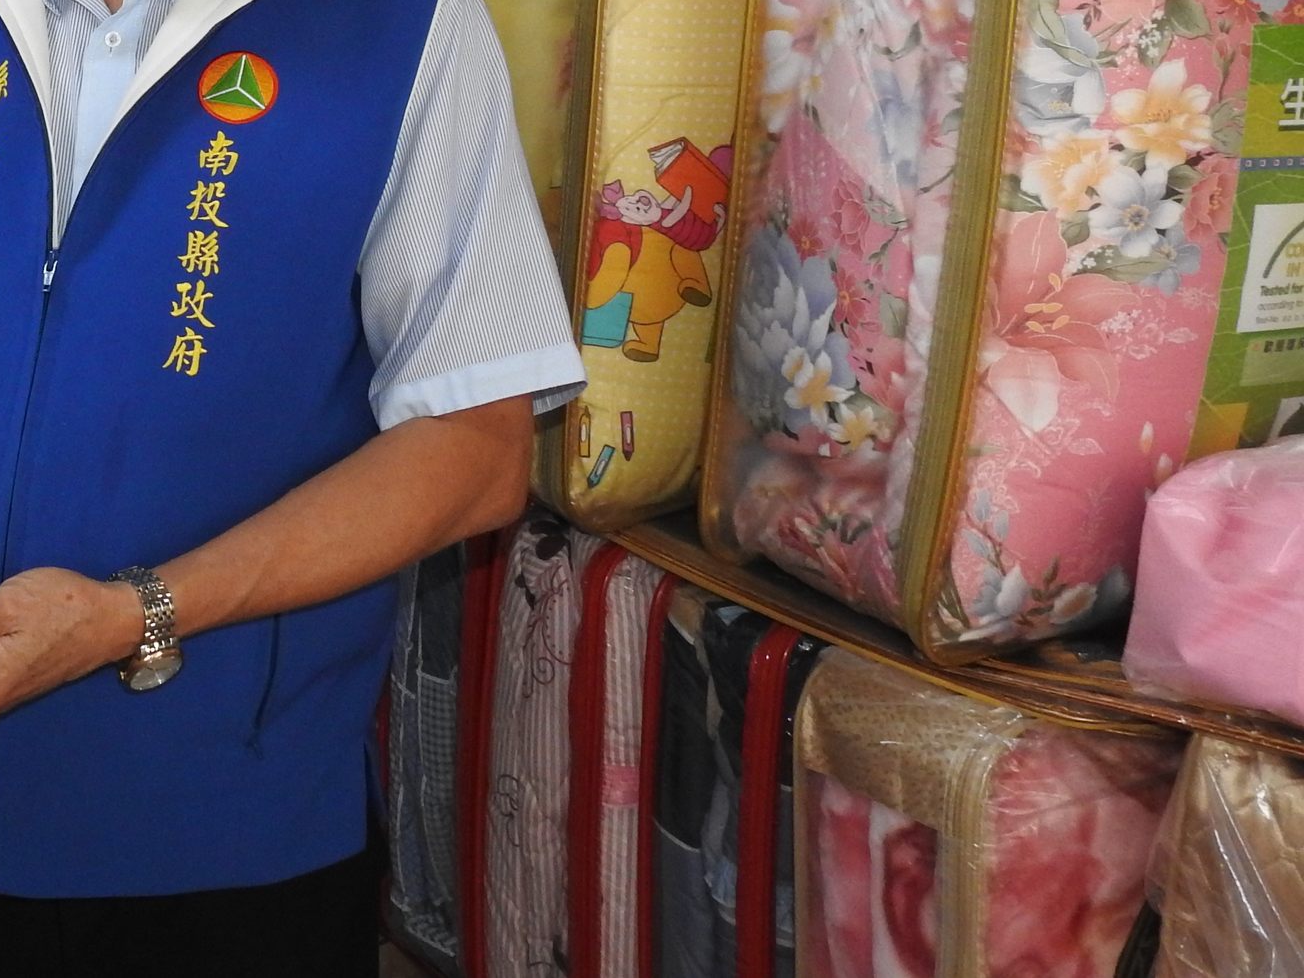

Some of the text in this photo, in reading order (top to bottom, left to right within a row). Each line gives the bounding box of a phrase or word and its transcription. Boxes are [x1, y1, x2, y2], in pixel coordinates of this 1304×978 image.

[162, 131, 240, 377] 南投縣政府
